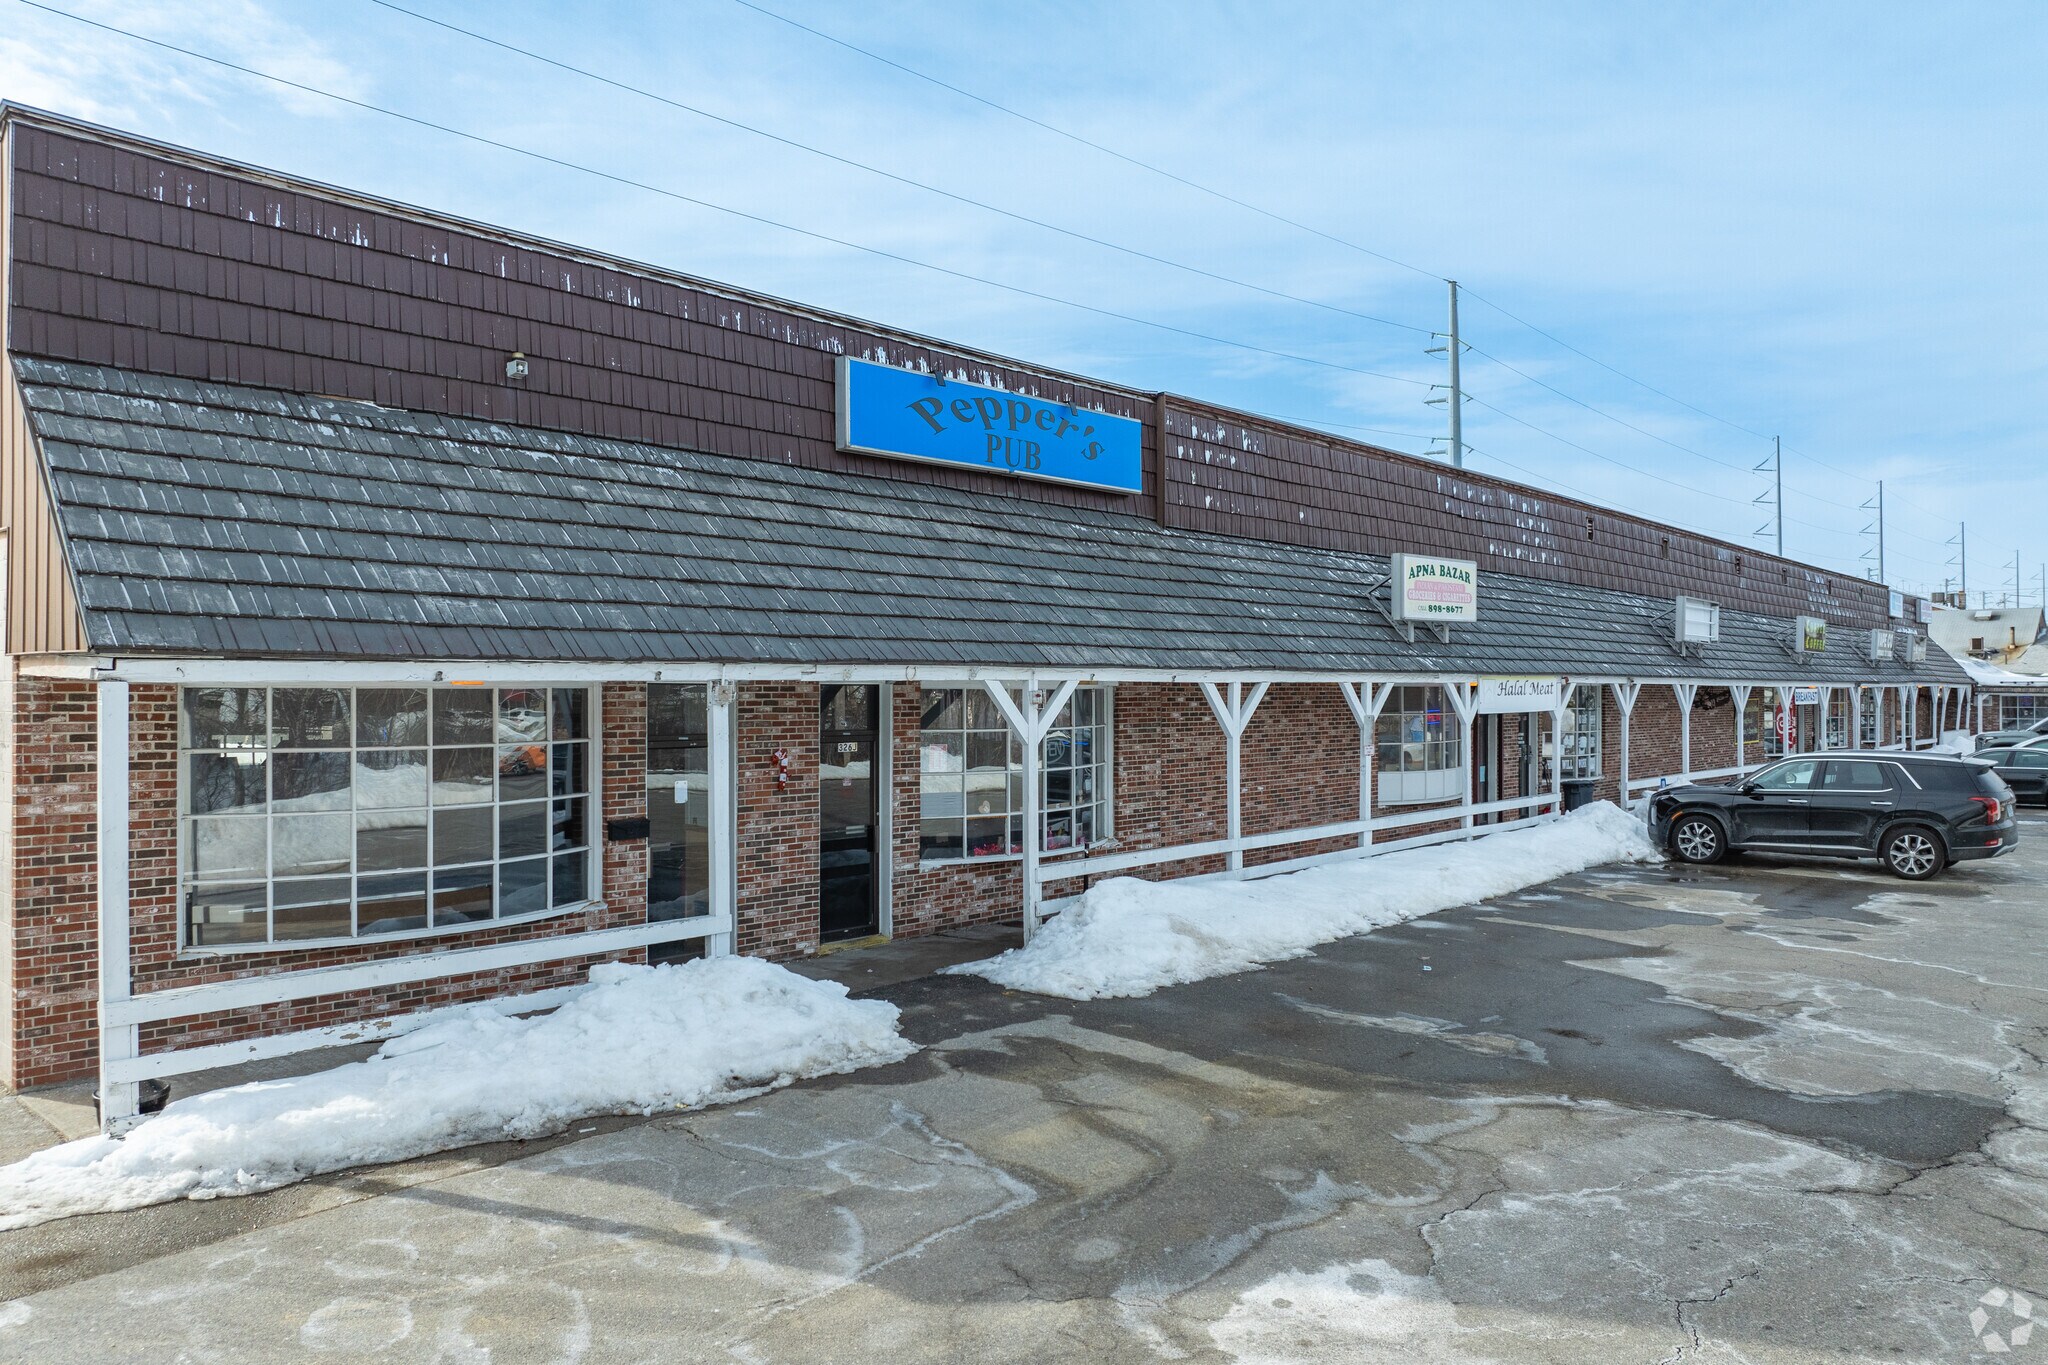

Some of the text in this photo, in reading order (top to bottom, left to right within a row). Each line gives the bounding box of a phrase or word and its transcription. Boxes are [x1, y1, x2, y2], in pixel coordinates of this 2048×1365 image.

[905, 396, 1106, 461] Pepper's
[985, 433, 1042, 471] PUB
[1408, 564, 1471, 584] APNA BAZAR
[1408, 590, 1437, 601] GROCERIES
[1442, 592, 1472, 603] CIGARETTES
[1428, 604, 1463, 614] 898-8677
[1497, 680, 1555, 697] Halal Meat
[838, 743, 857, 752] 326J
